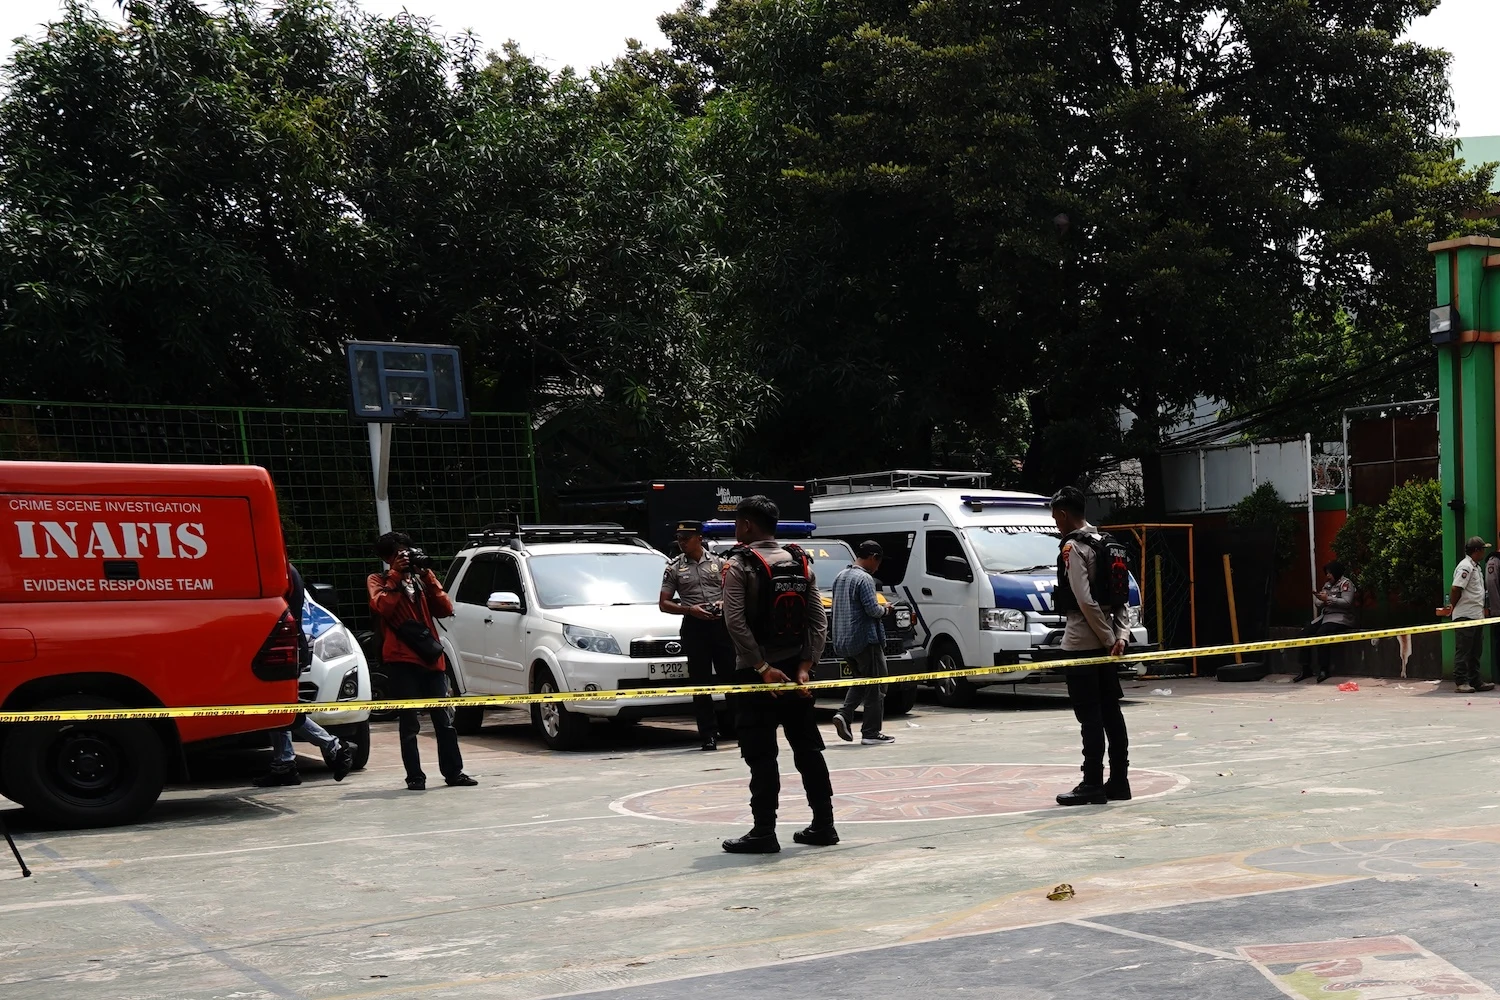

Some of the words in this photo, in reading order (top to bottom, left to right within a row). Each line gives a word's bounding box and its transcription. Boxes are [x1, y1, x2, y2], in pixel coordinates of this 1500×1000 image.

[9, 499, 53, 511] CRIME
[56, 500, 102, 512] SCENE
[104, 501, 201, 513] INVESTIGATION
[13, 520, 208, 559] INAFIS
[23, 579, 96, 592] EVIDENCE
[99, 578, 174, 591] RESPONSE
[176, 578, 214, 591] TEAM
[650, 664, 656, 674] B
[660, 663, 683, 674] 1202
